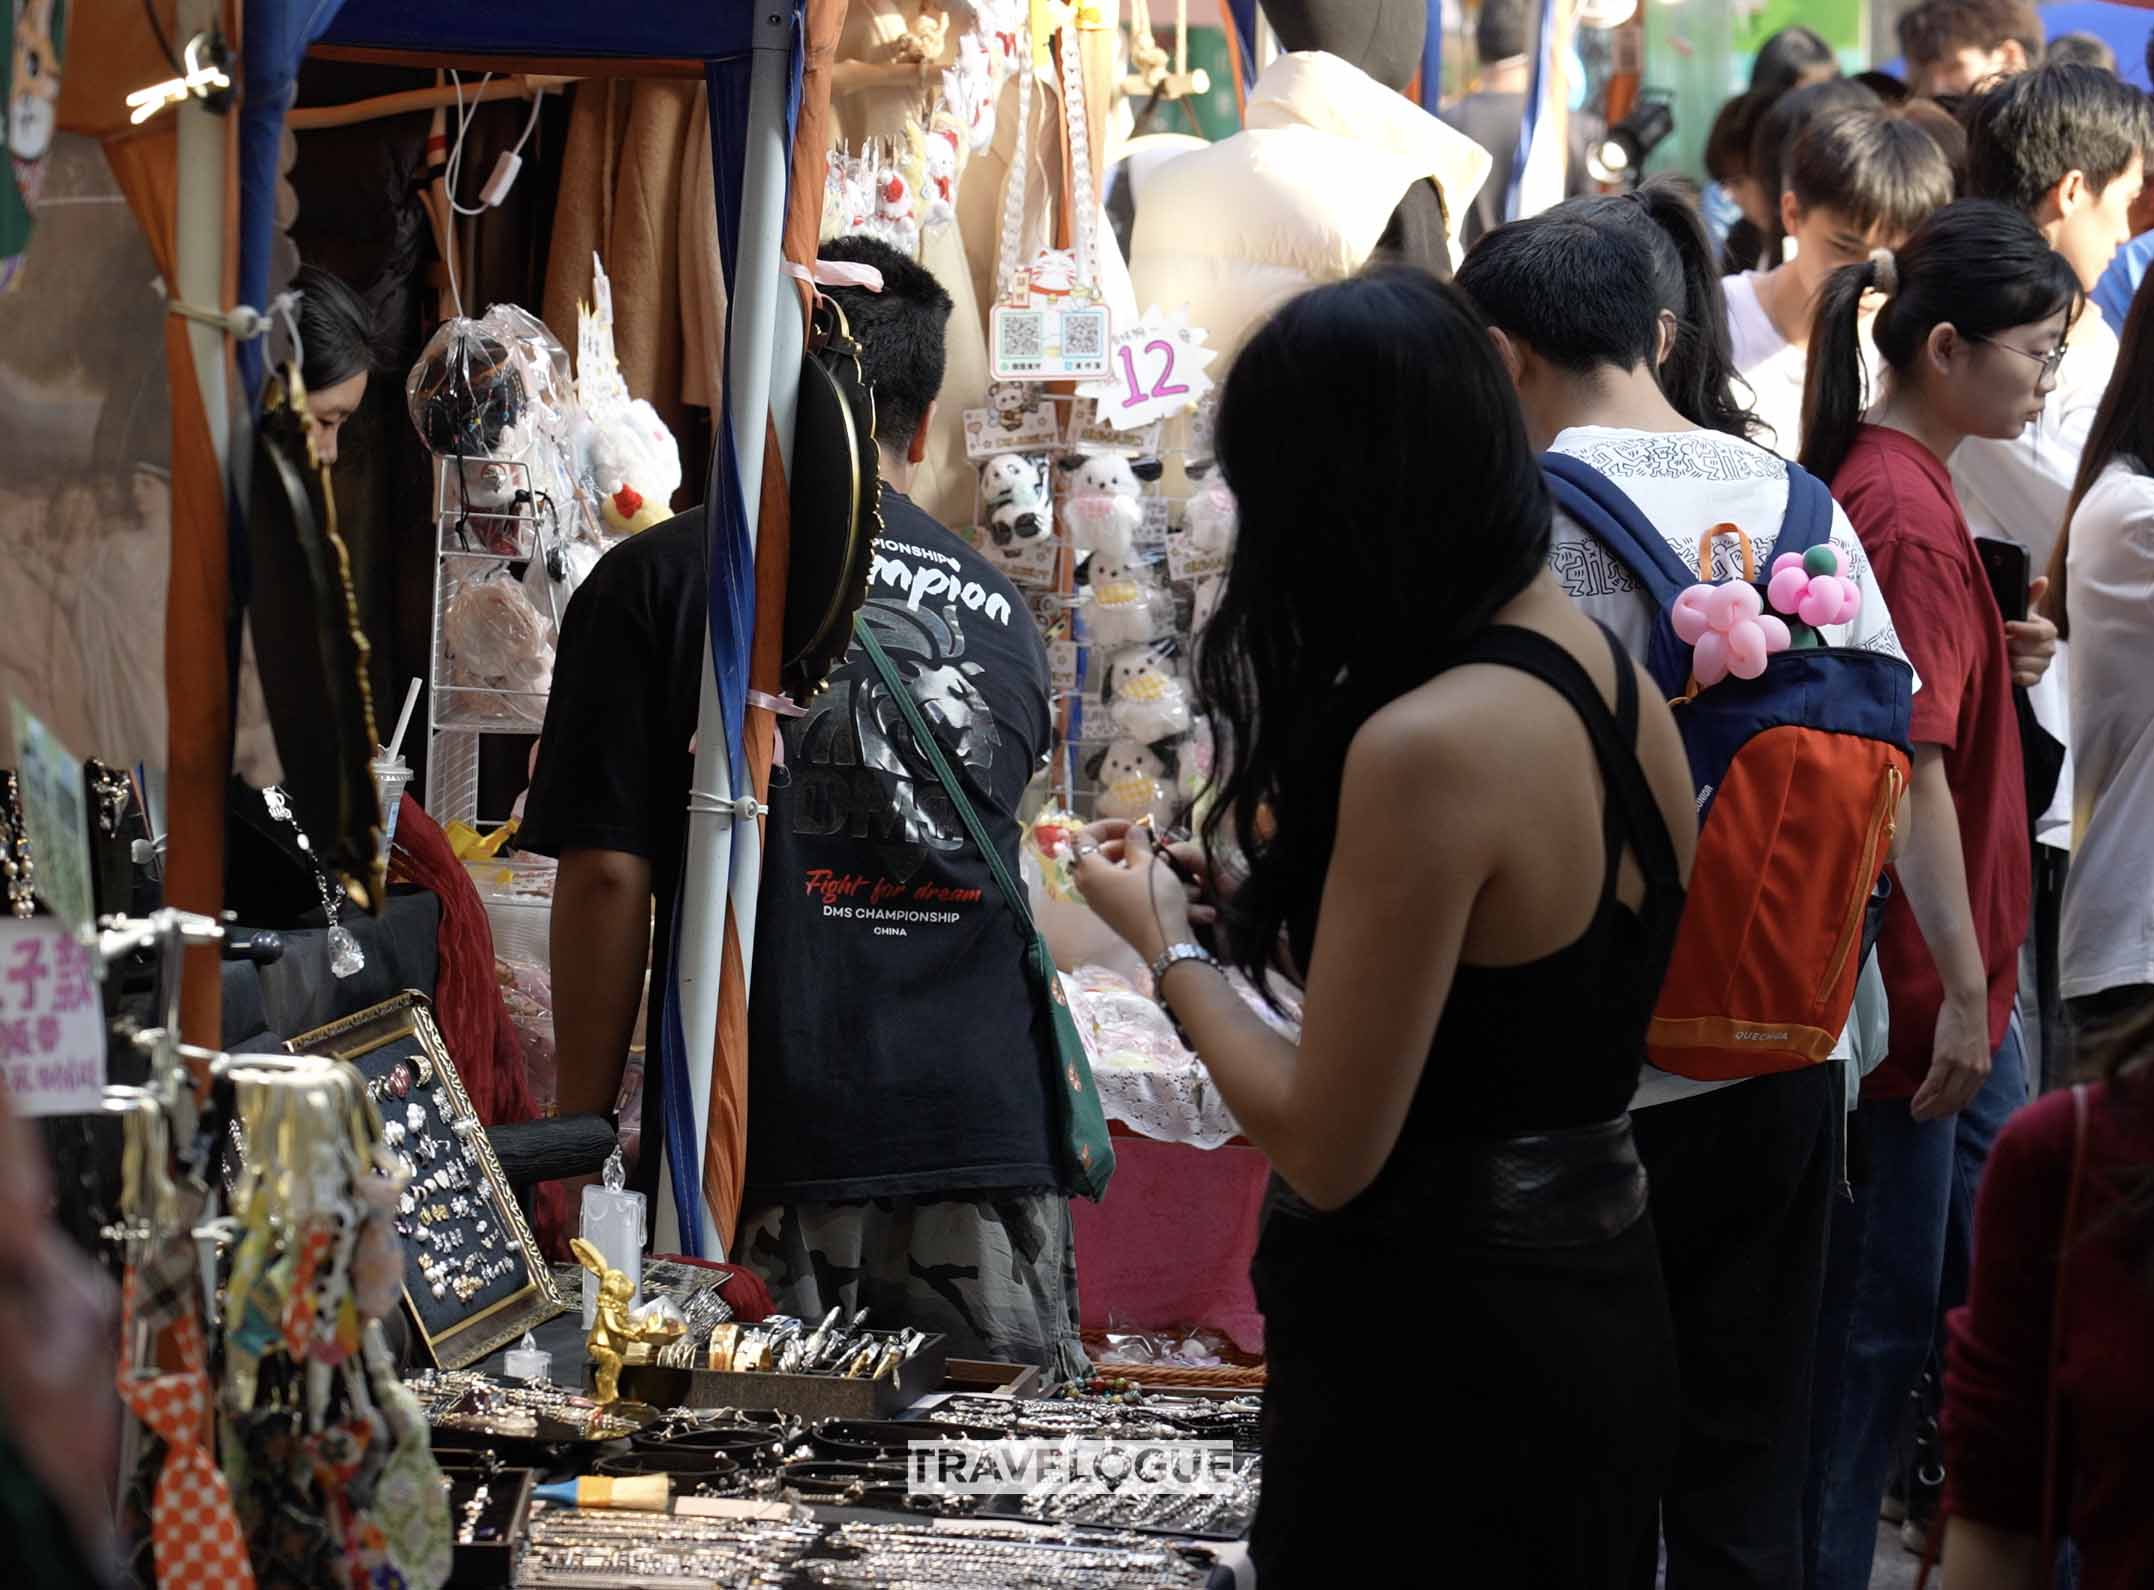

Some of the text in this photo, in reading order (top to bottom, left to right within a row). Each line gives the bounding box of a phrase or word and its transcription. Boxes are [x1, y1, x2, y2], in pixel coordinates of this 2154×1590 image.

[1117, 338, 1190, 409] 12
[804, 868, 983, 906] Fight for dream
[823, 905, 960, 924] DMS CHAMPIONSHIP
[873, 926, 908, 937] CHINA
